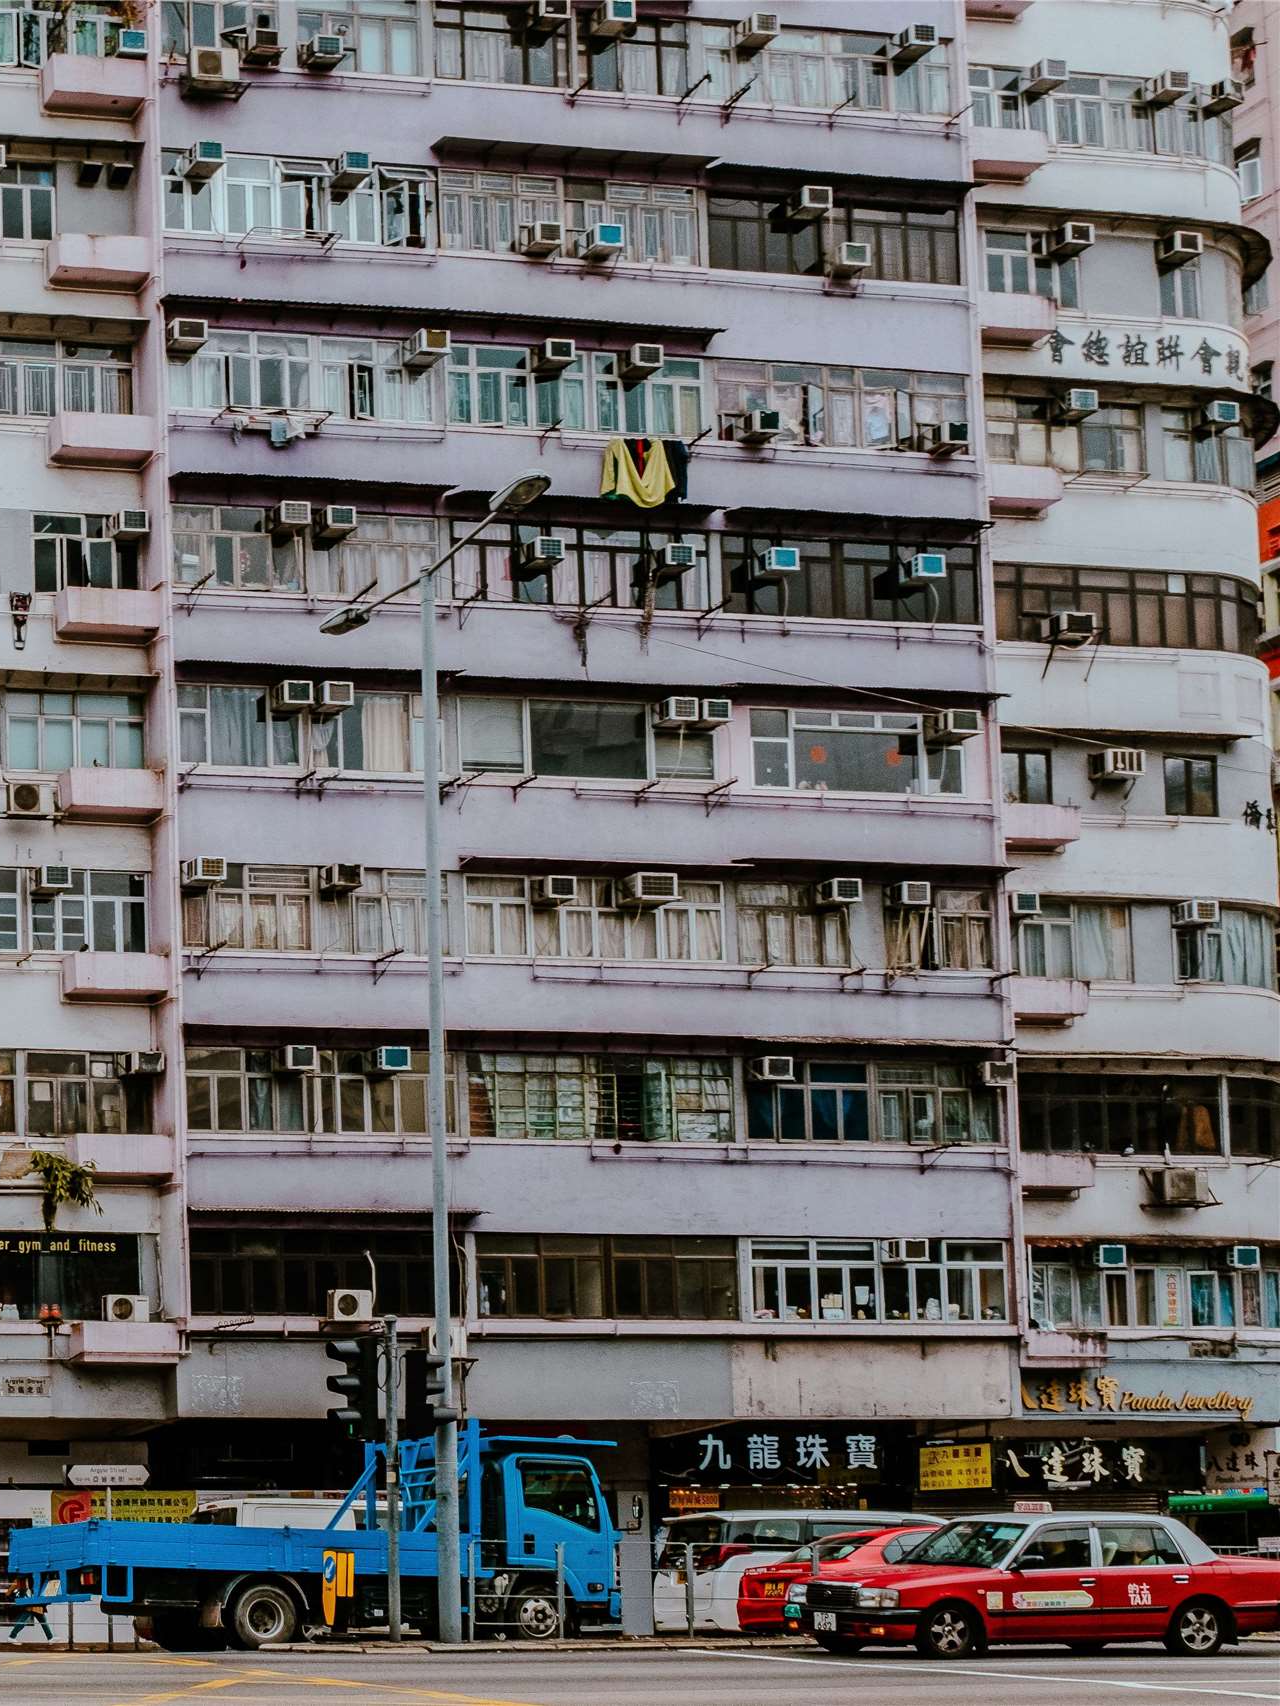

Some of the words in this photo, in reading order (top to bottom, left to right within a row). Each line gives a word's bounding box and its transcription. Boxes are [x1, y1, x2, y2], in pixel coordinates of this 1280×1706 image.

[1121, 1390, 1170, 1411] Panda
[1176, 1391, 1254, 1420] Jewellery
[698, 1433, 878, 1471] 九龍珠寶
[997, 1445, 1145, 1483] 八達珠寶
[1127, 1582, 1150, 1594] 的士
[1128, 1593, 1152, 1606] TAXI
